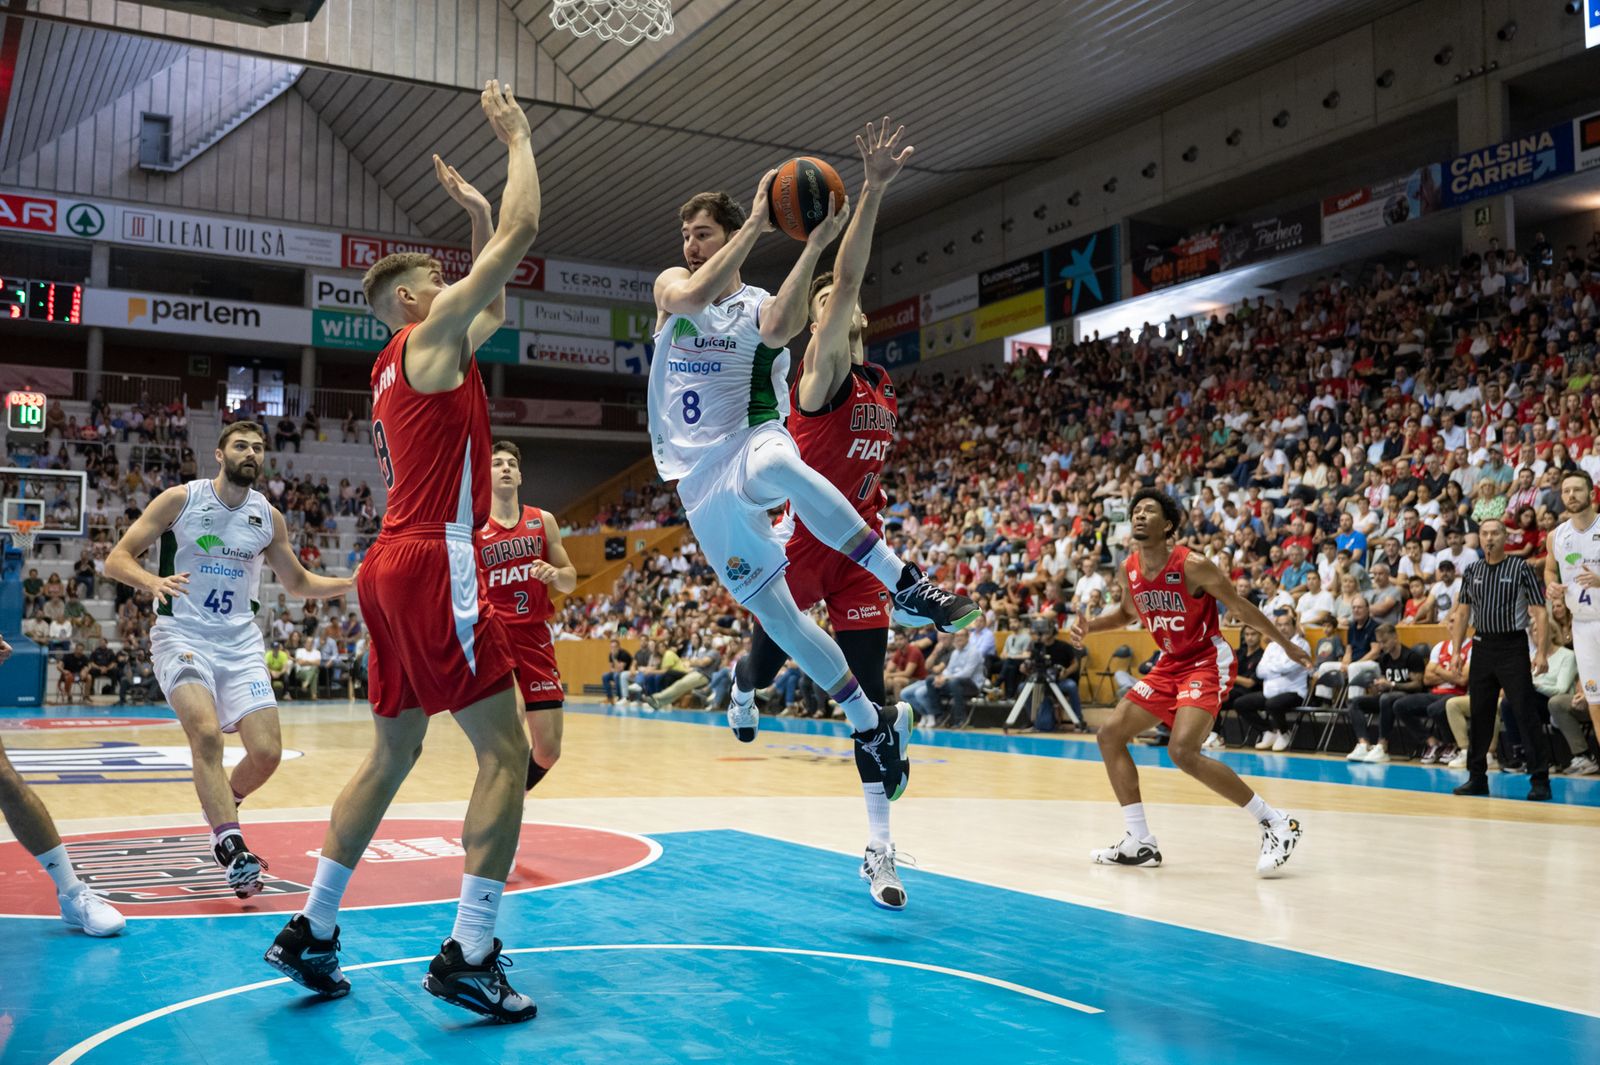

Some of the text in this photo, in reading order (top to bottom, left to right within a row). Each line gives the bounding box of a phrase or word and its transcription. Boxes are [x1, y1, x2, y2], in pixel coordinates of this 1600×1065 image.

[1450, 131, 1554, 176] CALSINA
[157, 218, 214, 249] LLEAL
[223, 225, 286, 257] TULSÀ
[152, 299, 261, 328] parlem
[20, 403, 42, 425] 10
[682, 390, 701, 424] 8
[482, 536, 542, 567] GIRONA
[200, 563, 245, 580] málaga
[203, 588, 235, 615] 45
[514, 590, 529, 615] 2
[1578, 588, 1592, 606] 4
